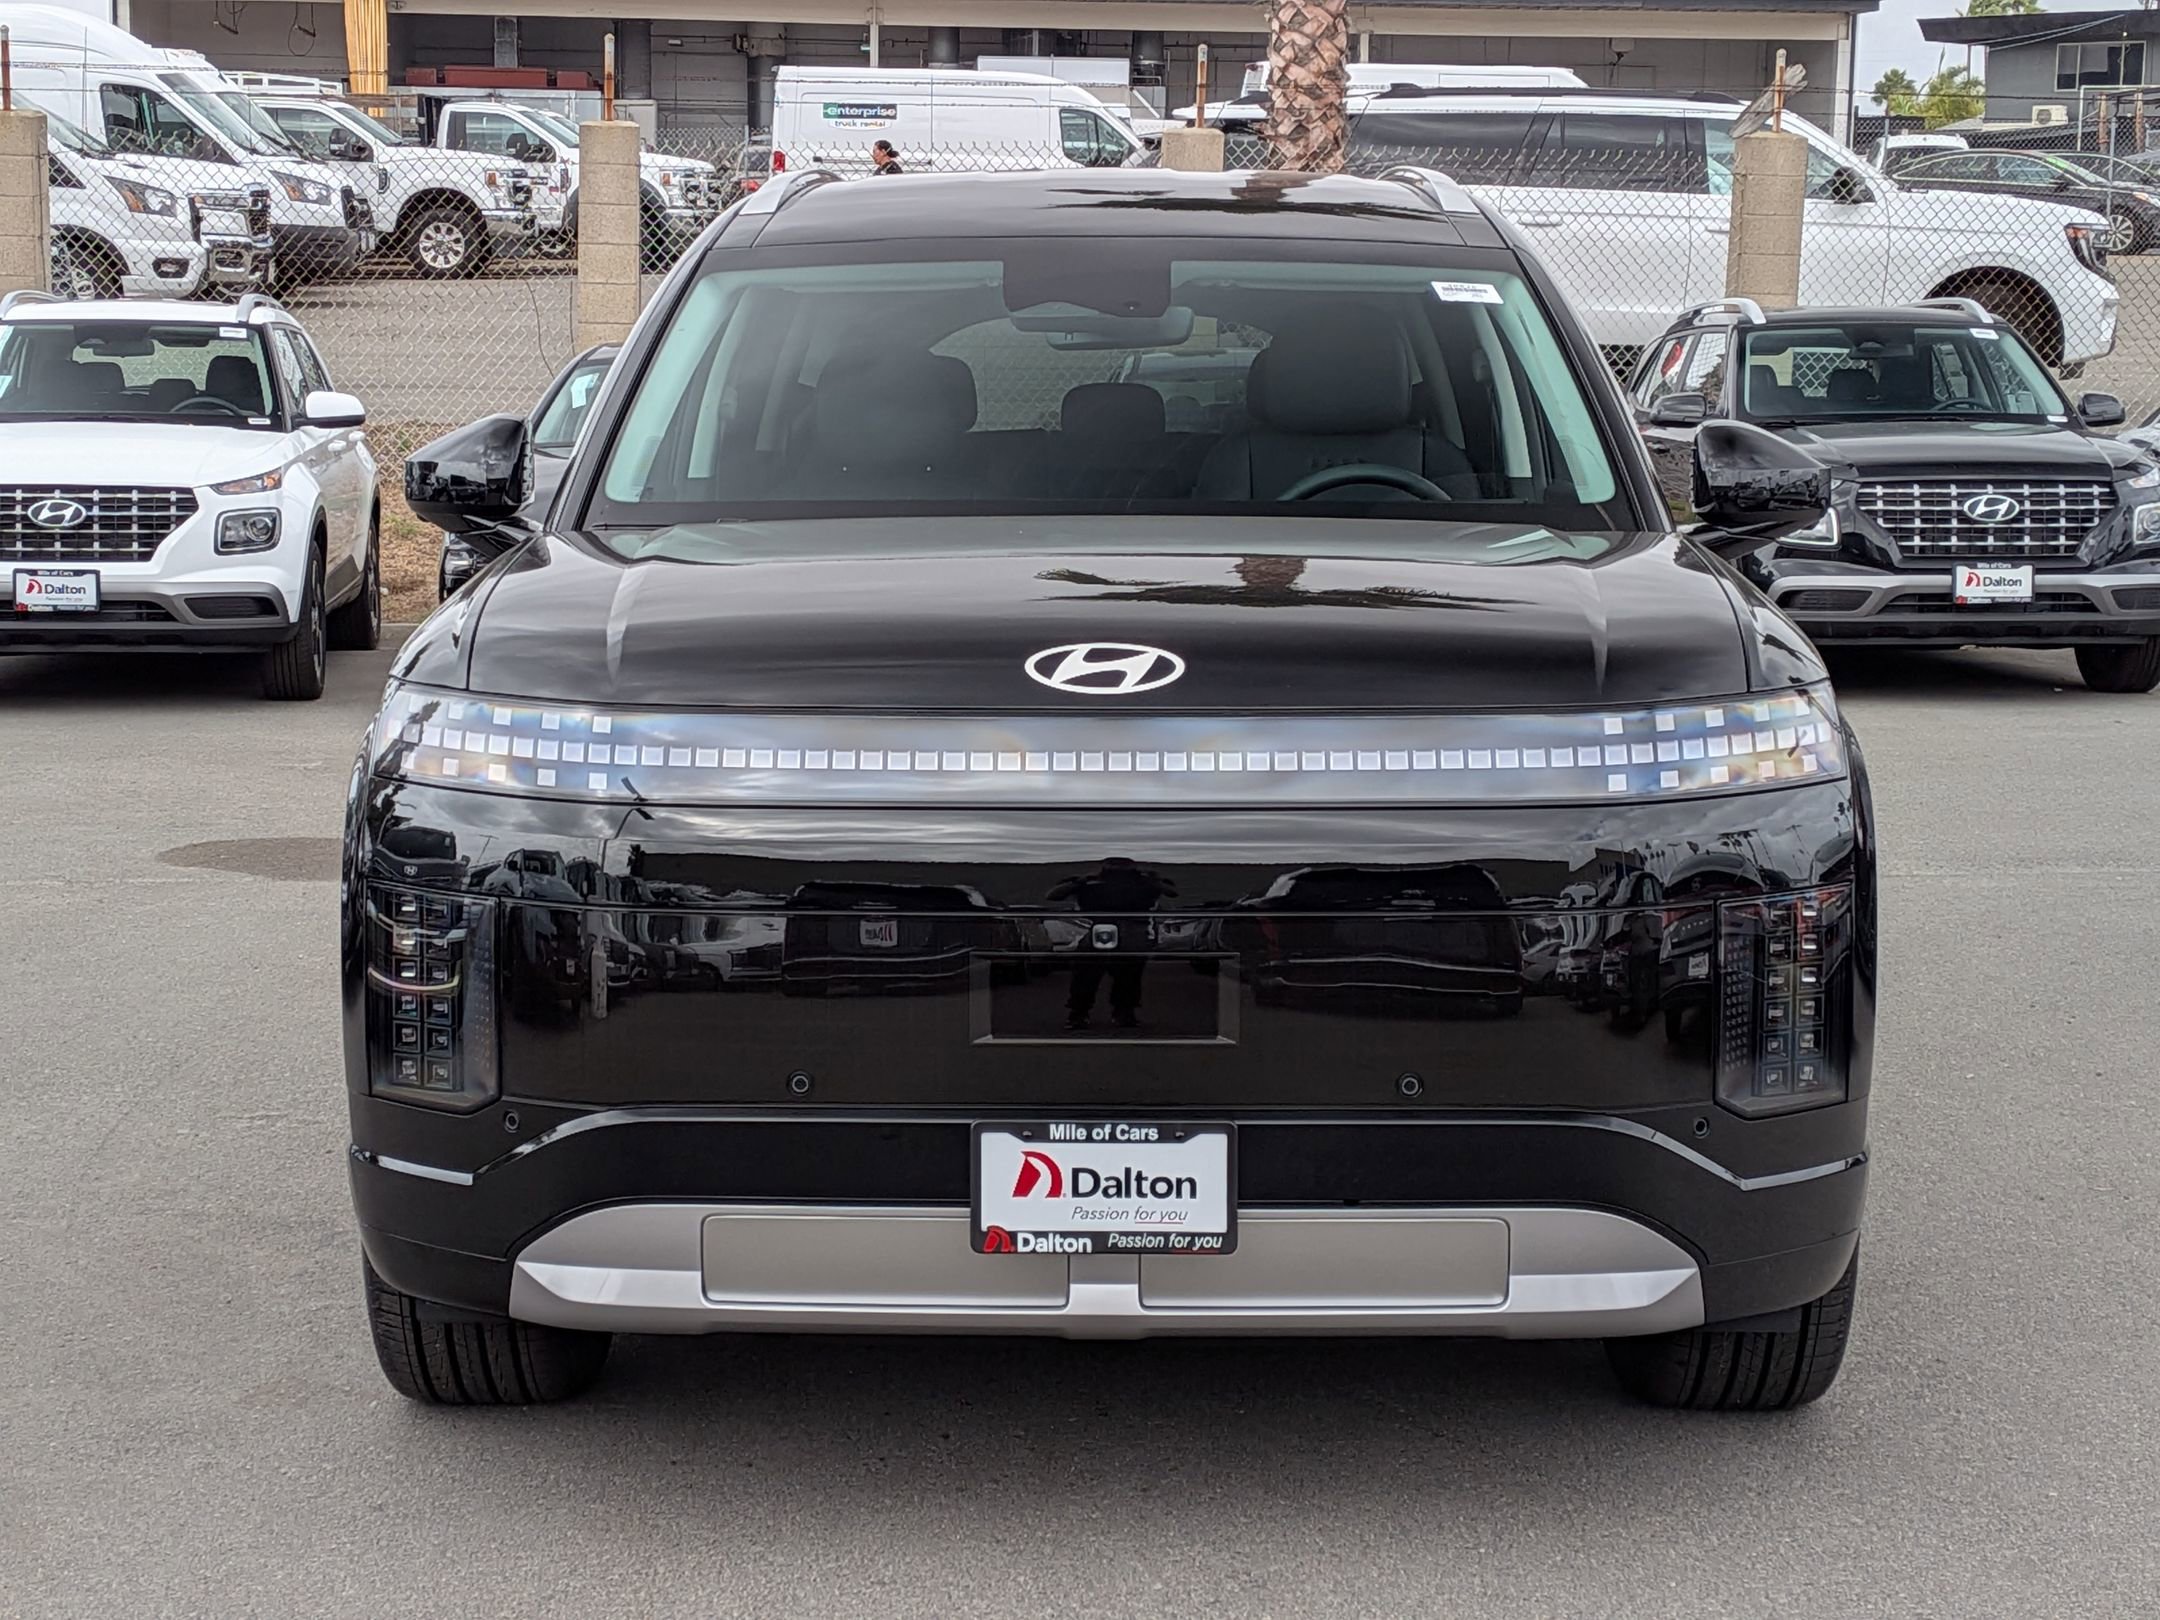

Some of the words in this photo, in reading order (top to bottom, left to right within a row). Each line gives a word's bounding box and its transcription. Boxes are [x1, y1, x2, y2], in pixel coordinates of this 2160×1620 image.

[824, 106, 896, 118] enterprise
[44, 584, 86, 594] Dalton
[1983, 576, 2022, 587] Dalton
[1049, 1123, 1087, 1140] Mile
[1091, 1123, 1111, 1140] of
[1115, 1124, 1159, 1141] Cars
[1071, 1166, 1197, 1199] Dalton
[1071, 1206, 1129, 1220] Passion
[1134, 1206, 1157, 1220] for
[1159, 1210, 1188, 1223] you
[1017, 1232, 1092, 1253] Dalton
[1107, 1233, 1165, 1248] Passion
[1168, 1233, 1191, 1248] for
[1191, 1236, 1223, 1251] you
